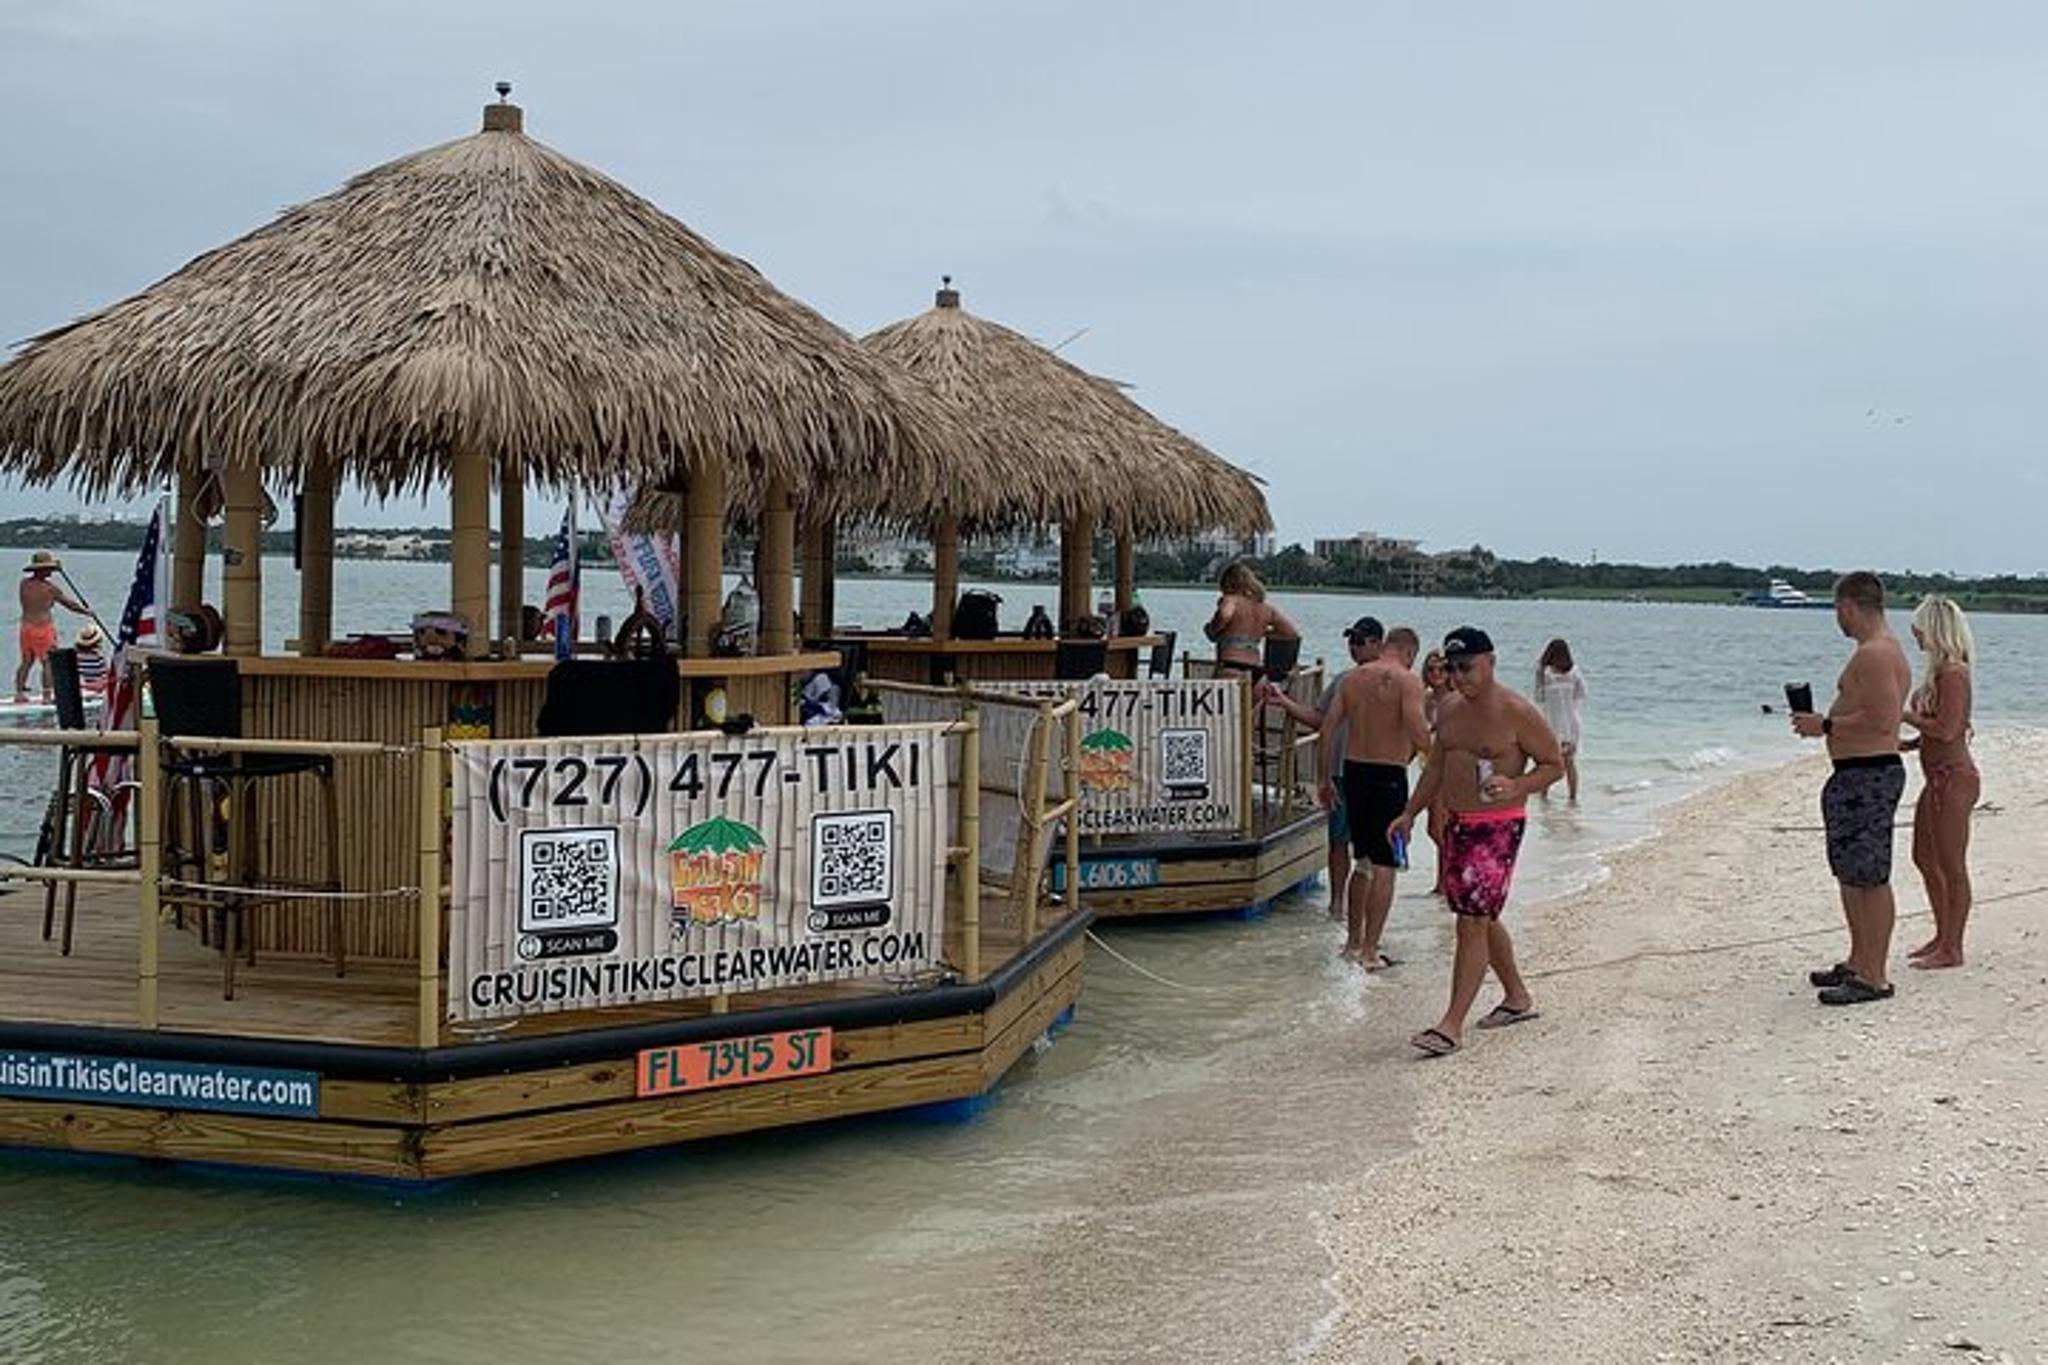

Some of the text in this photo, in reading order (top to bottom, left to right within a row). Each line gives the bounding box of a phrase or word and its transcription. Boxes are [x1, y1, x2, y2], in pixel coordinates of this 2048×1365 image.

[1078, 687, 1225, 718] 477-TIKI
[488, 742, 921, 823] (727) 477-TIKI
[470, 931, 925, 1009] CRUISINTIKISCLEARWATER.COM
[648, 1031, 823, 1090] FL 7345 ST
